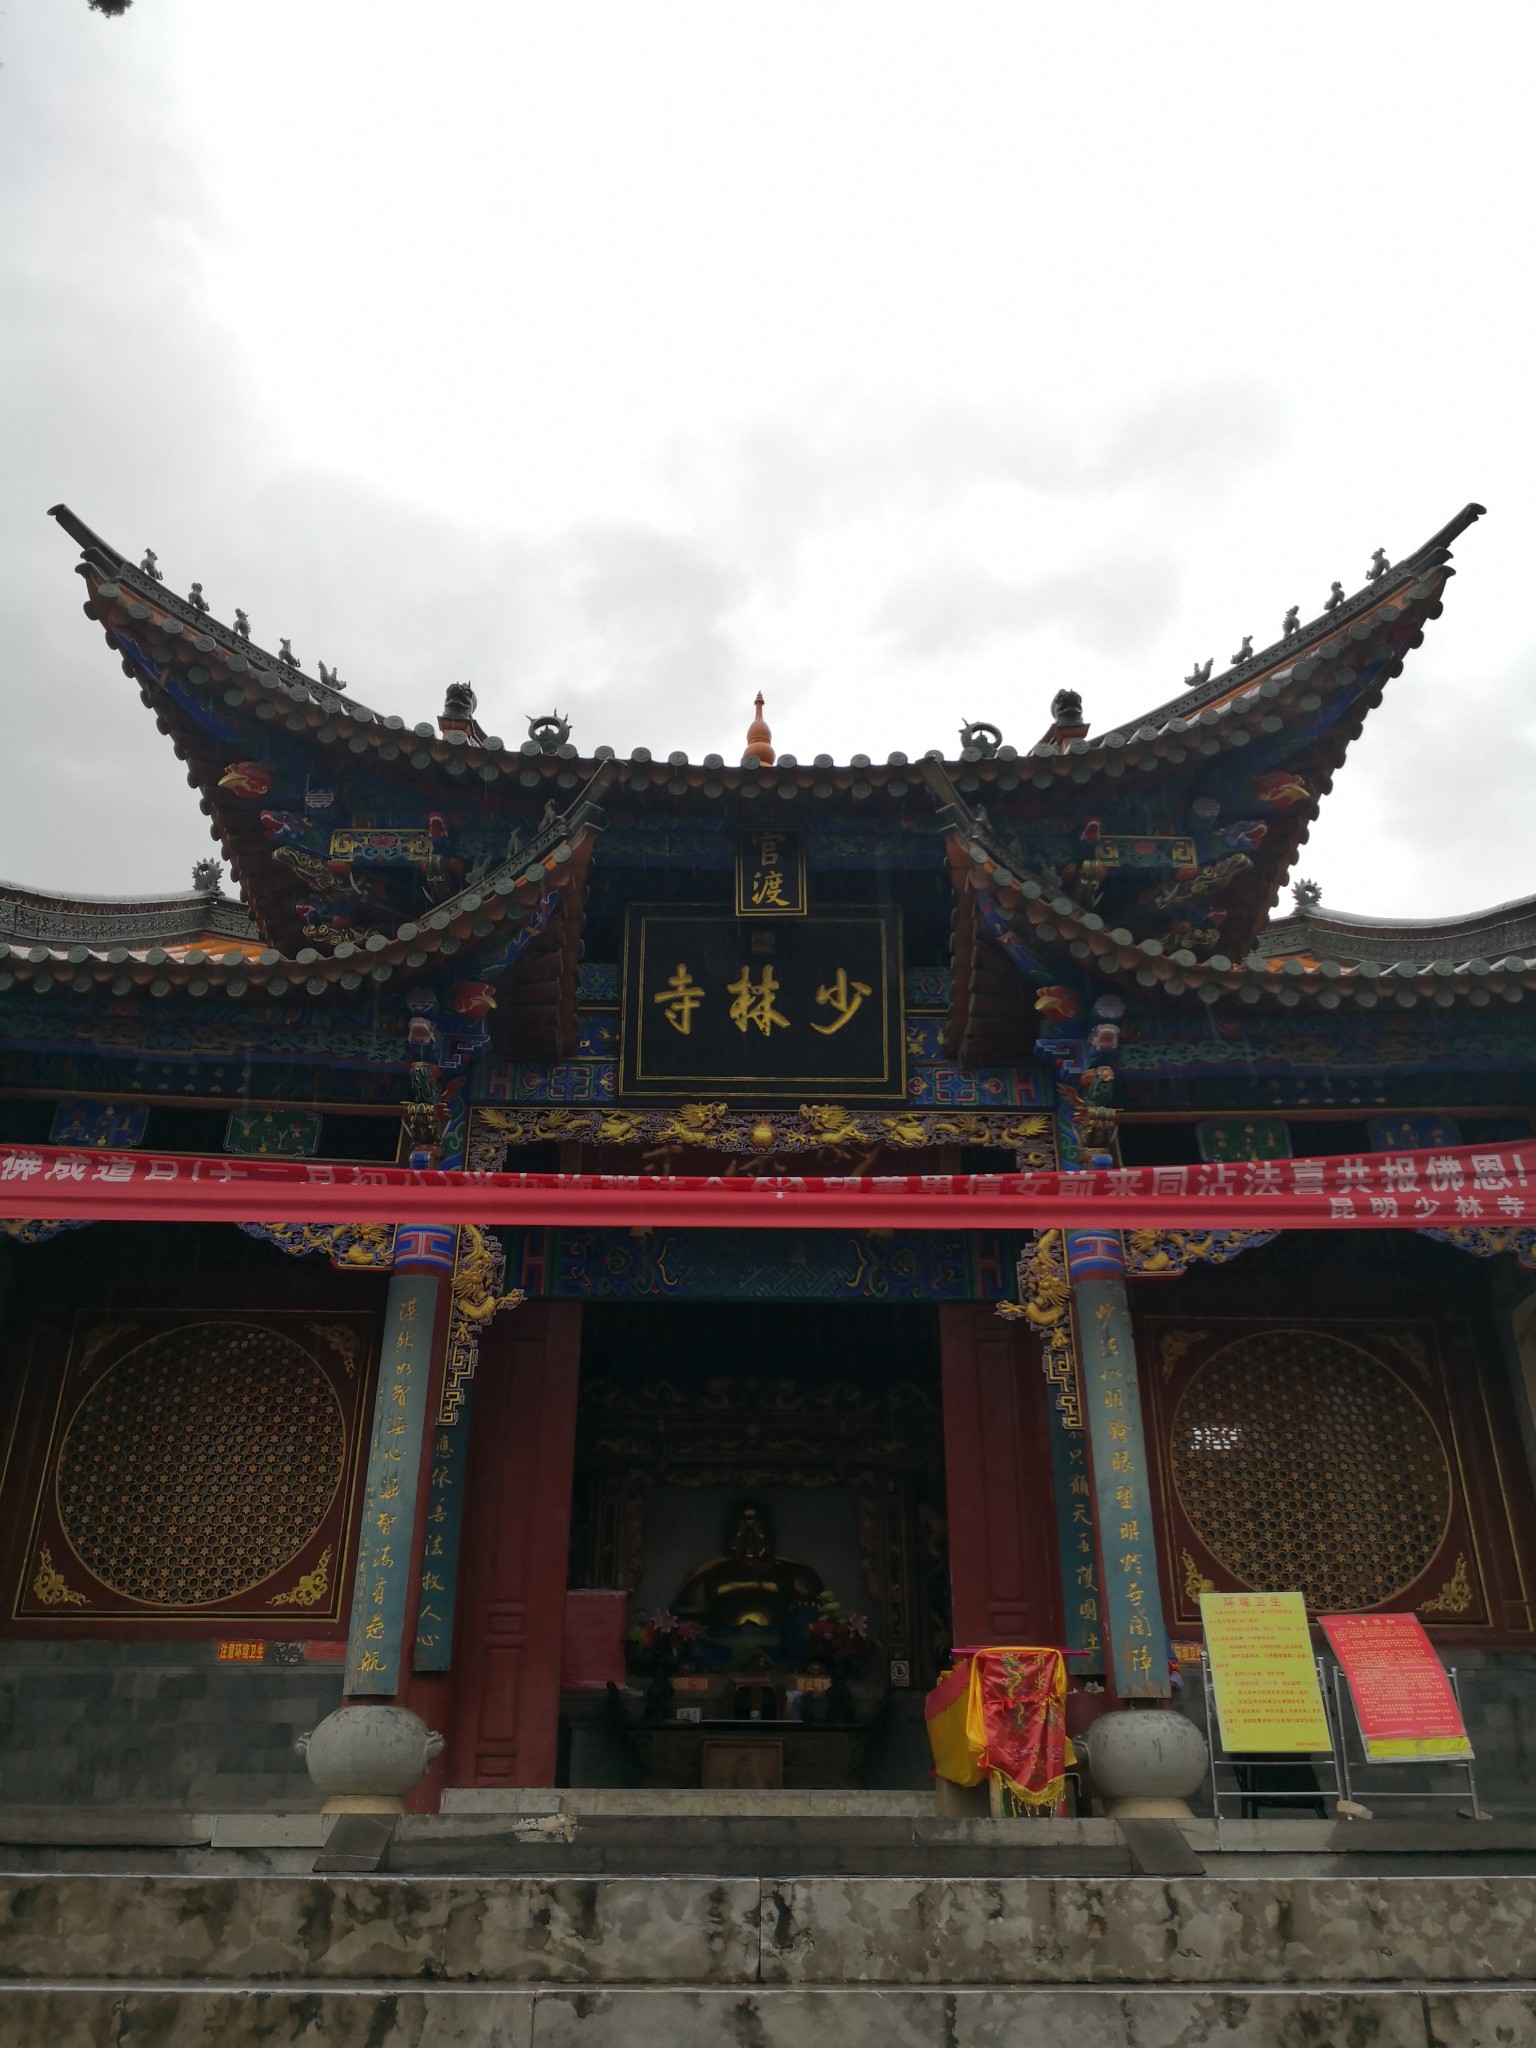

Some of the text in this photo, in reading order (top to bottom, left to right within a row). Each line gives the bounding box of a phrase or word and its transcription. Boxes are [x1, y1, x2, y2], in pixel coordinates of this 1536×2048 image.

[751, 831, 791, 907] 官渡
[1329, 1195, 1525, 1219] 昆明少林寺
[1223, 1596, 1282, 1607] 环境卫生
[219, 1643, 265, 1659] 注意环境卫生
